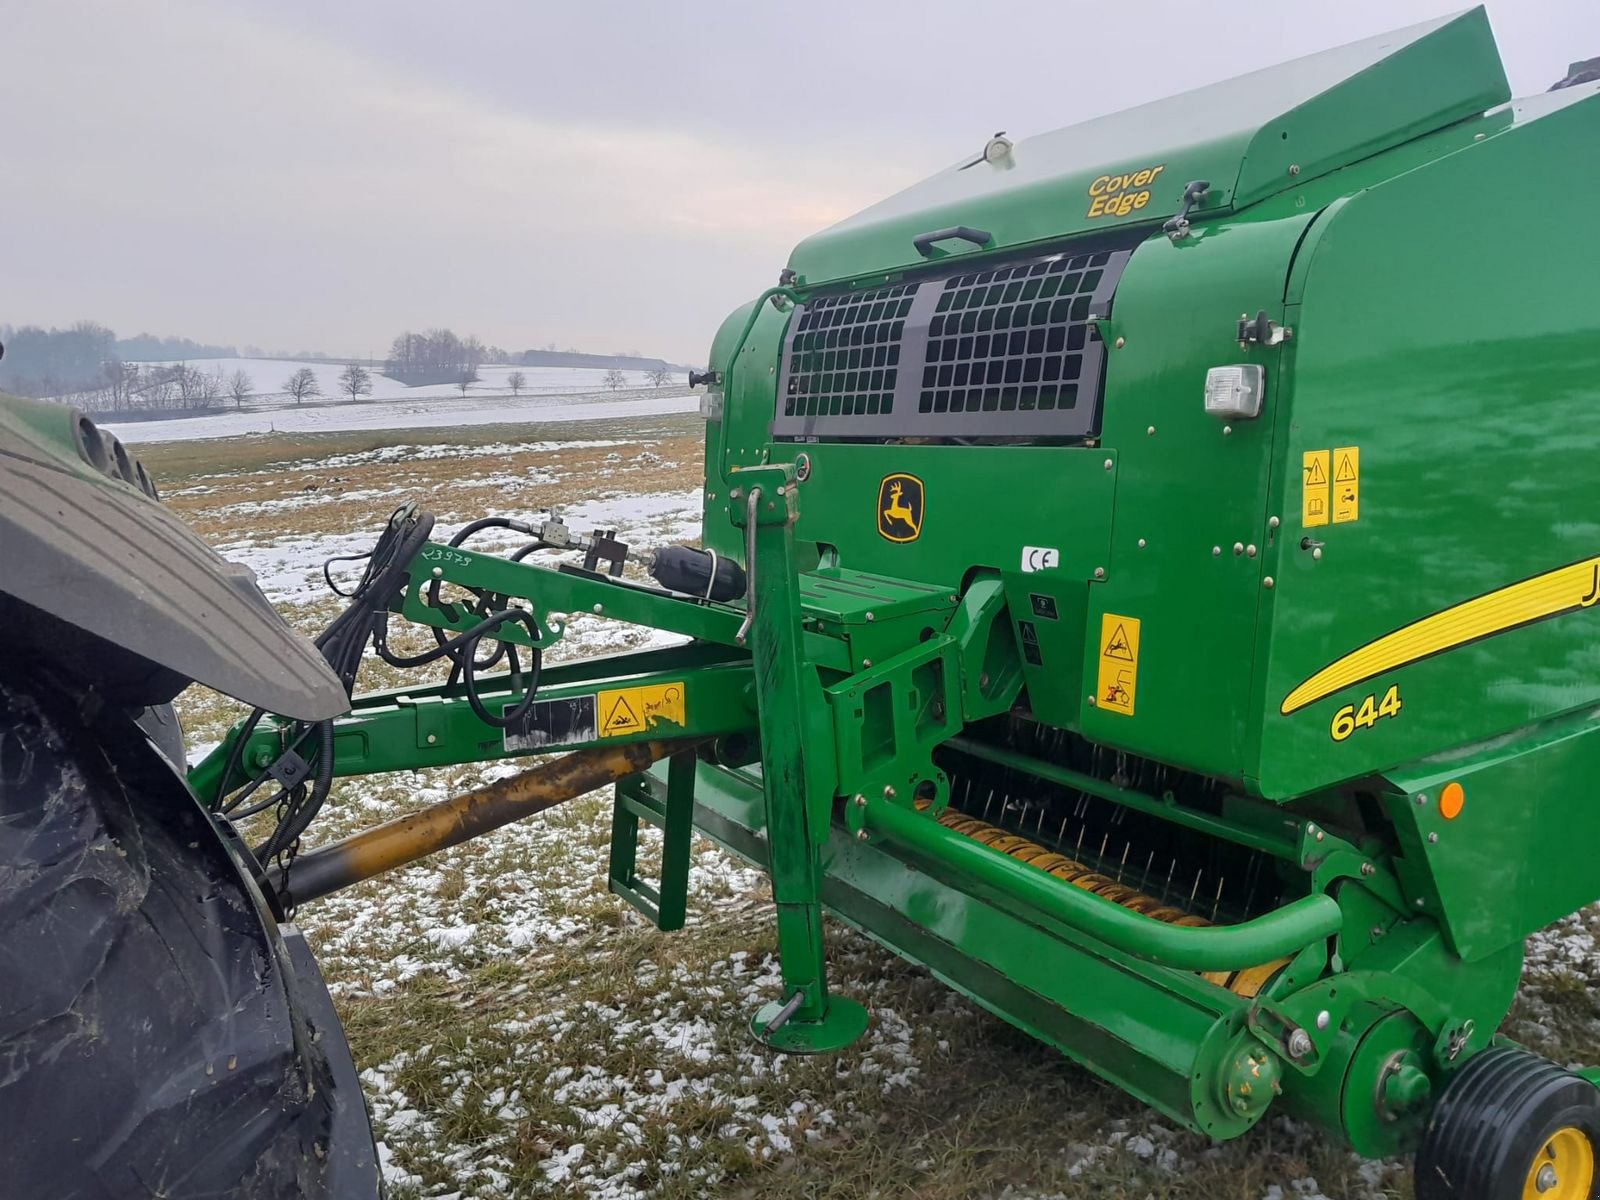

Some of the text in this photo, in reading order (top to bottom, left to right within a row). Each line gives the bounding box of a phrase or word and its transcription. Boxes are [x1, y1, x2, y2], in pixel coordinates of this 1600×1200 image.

[1088, 165, 1165, 196] Cover
[1087, 191, 1150, 218] Edge
[1029, 549, 1052, 571] CE
[1330, 684, 1402, 741] 644
